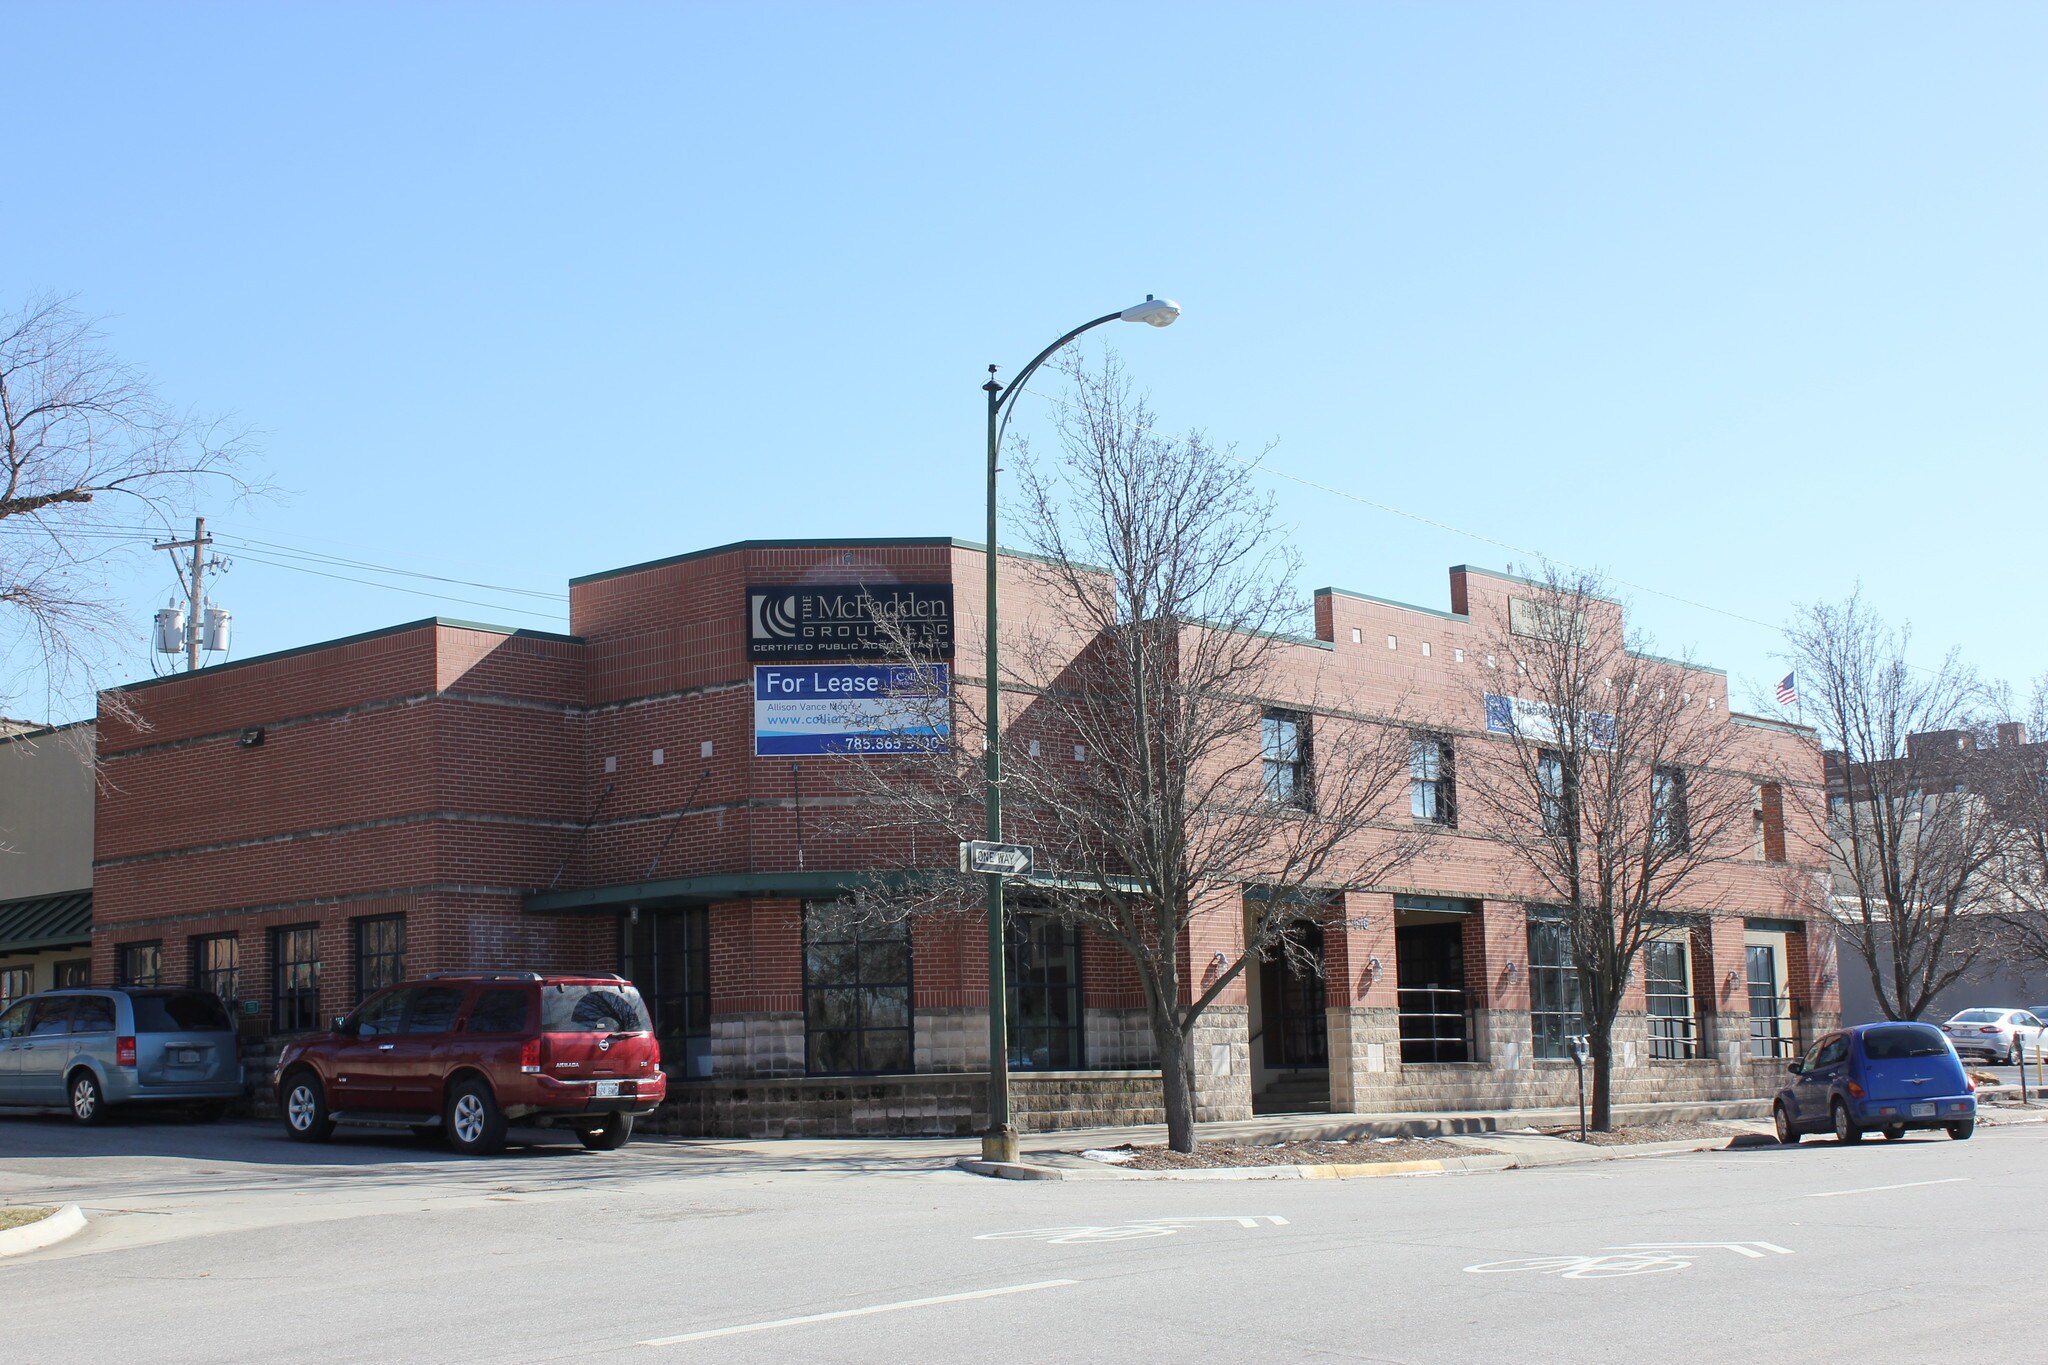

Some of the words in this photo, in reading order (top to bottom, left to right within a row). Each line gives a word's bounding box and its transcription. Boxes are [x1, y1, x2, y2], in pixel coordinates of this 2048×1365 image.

[802, 595, 812, 620] THE
[816, 592, 948, 619] McFadden
[753, 643, 814, 652] CERTIFIED
[818, 642, 859, 651] PUBLIC
[767, 672, 805, 693] For
[814, 672, 879, 692] Lease
[767, 702, 797, 711] Allison
[800, 702, 827, 711] Vance
[978, 851, 994, 863] ONE
[997, 853, 1014, 864] WAY
